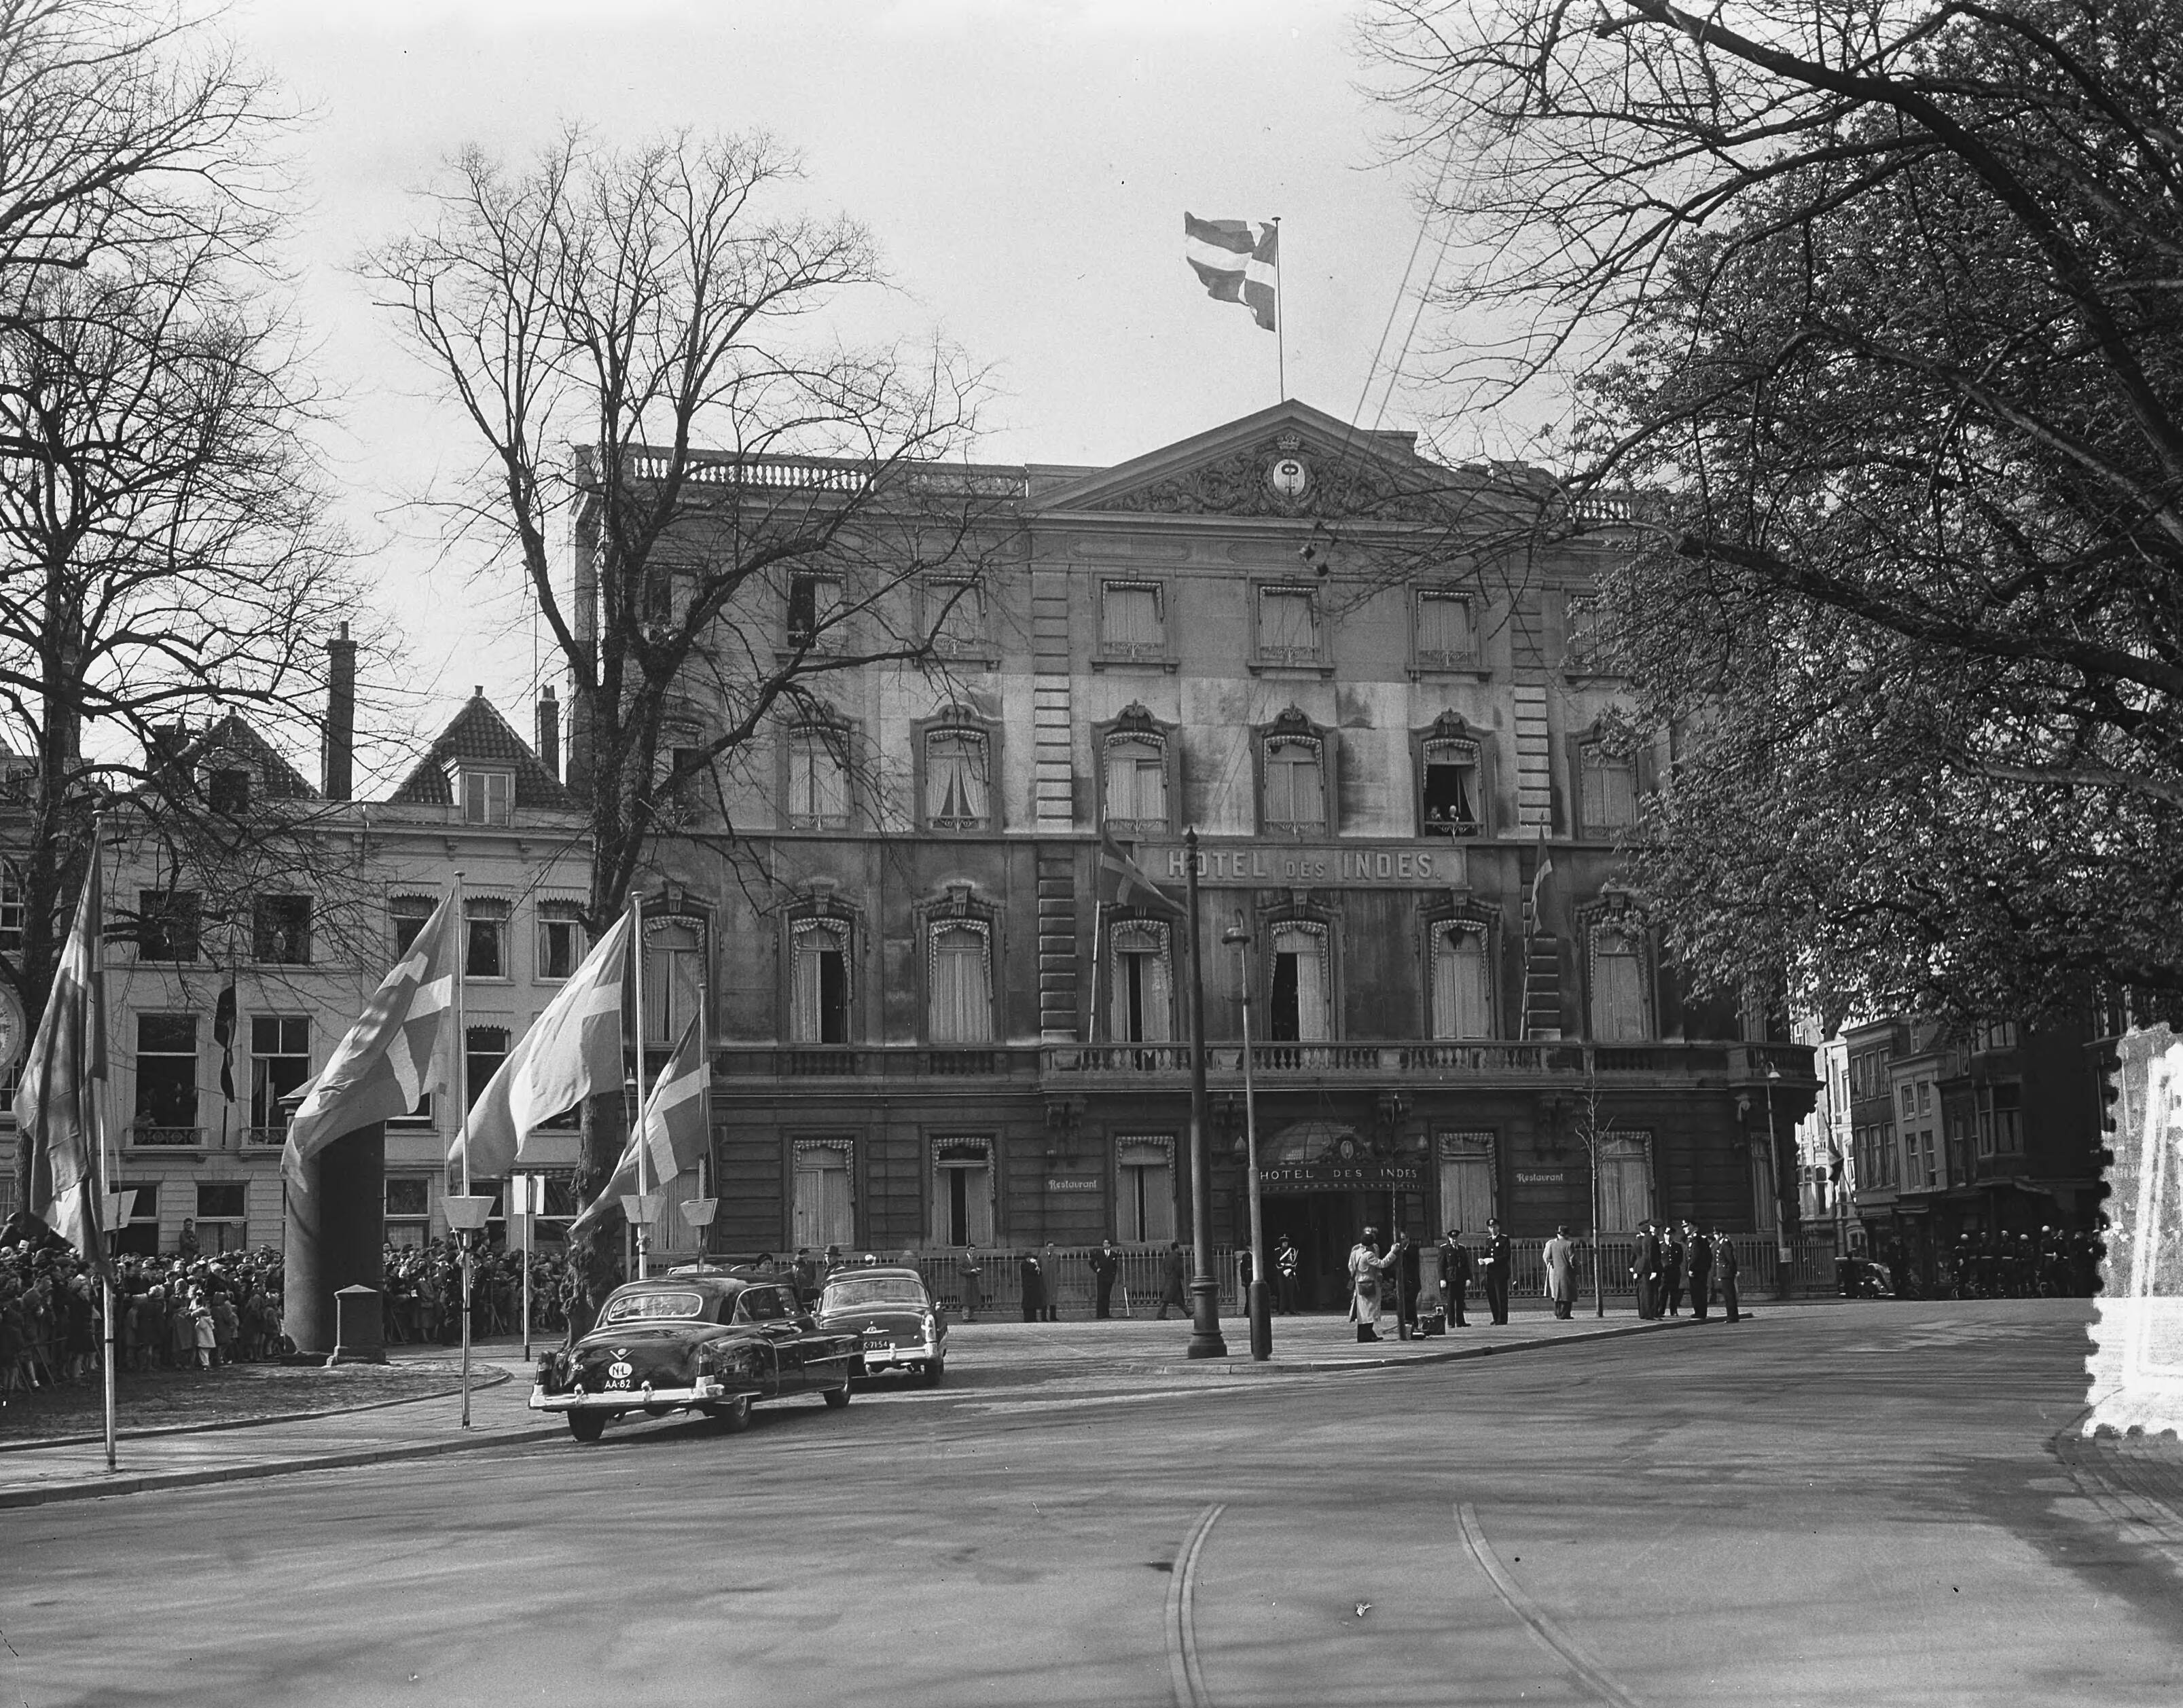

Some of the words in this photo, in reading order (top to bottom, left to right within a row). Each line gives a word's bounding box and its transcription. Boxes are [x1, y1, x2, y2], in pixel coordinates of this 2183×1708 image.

[1169, 850, 1266, 878] HOTEL
[1286, 860, 1325, 878] DES
[1260, 1169, 1314, 1180] HOTEL
[1333, 1169, 1363, 1178] DES
[1380, 1168, 1417, 1178] INDES
[1516, 1173, 1564, 1183] Restaurant
[1048, 1180, 1096, 1190] Restaurant
[605, 1379, 630, 1389] AA-82
